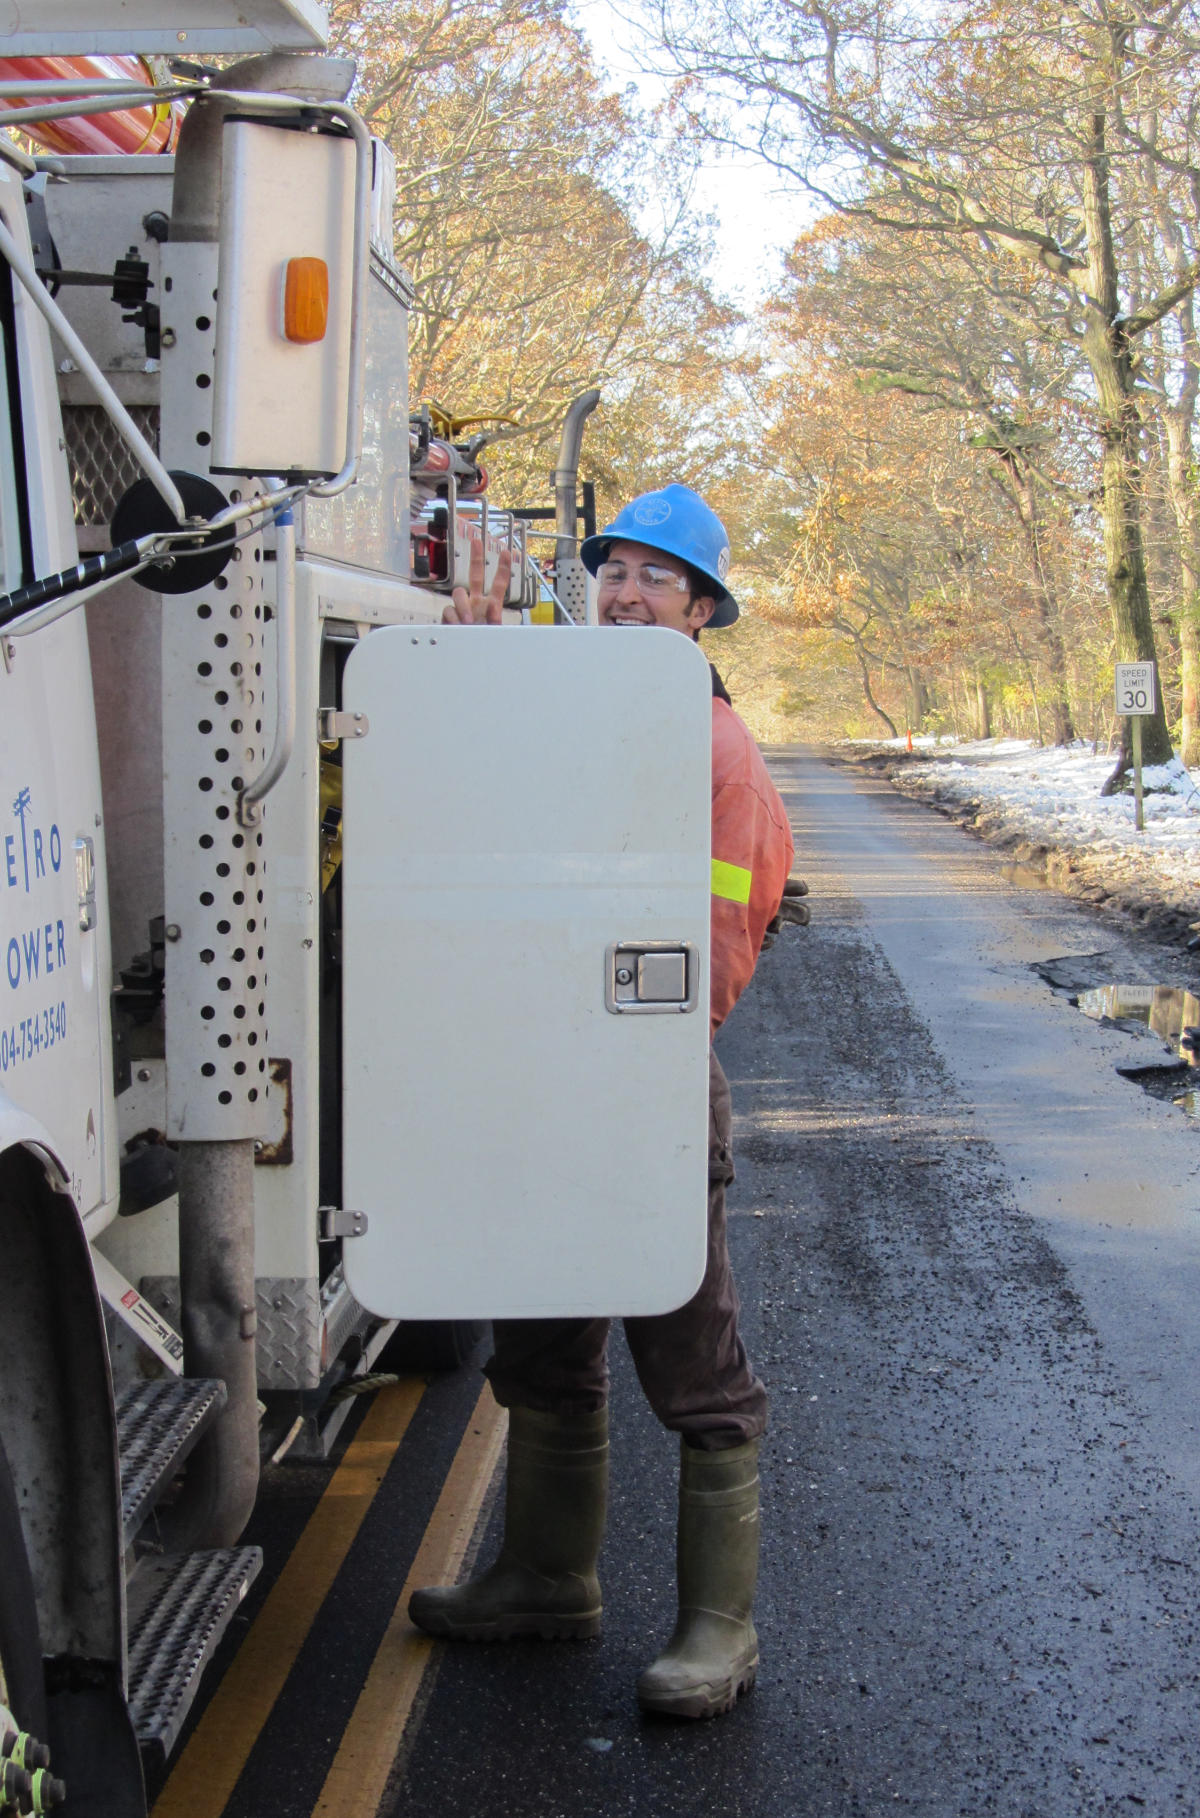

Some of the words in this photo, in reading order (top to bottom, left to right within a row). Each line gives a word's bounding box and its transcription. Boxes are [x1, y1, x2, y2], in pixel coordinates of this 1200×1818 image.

[1121, 669, 1147, 678] SPEED
[1124, 679, 1145, 688] LIMIT
[1123, 690, 1147, 709] 30
[5, 786, 62, 893] ETRO
[7, 919, 66, 990] OWER
[0, 1000, 66, 1073] 04-754-3540
